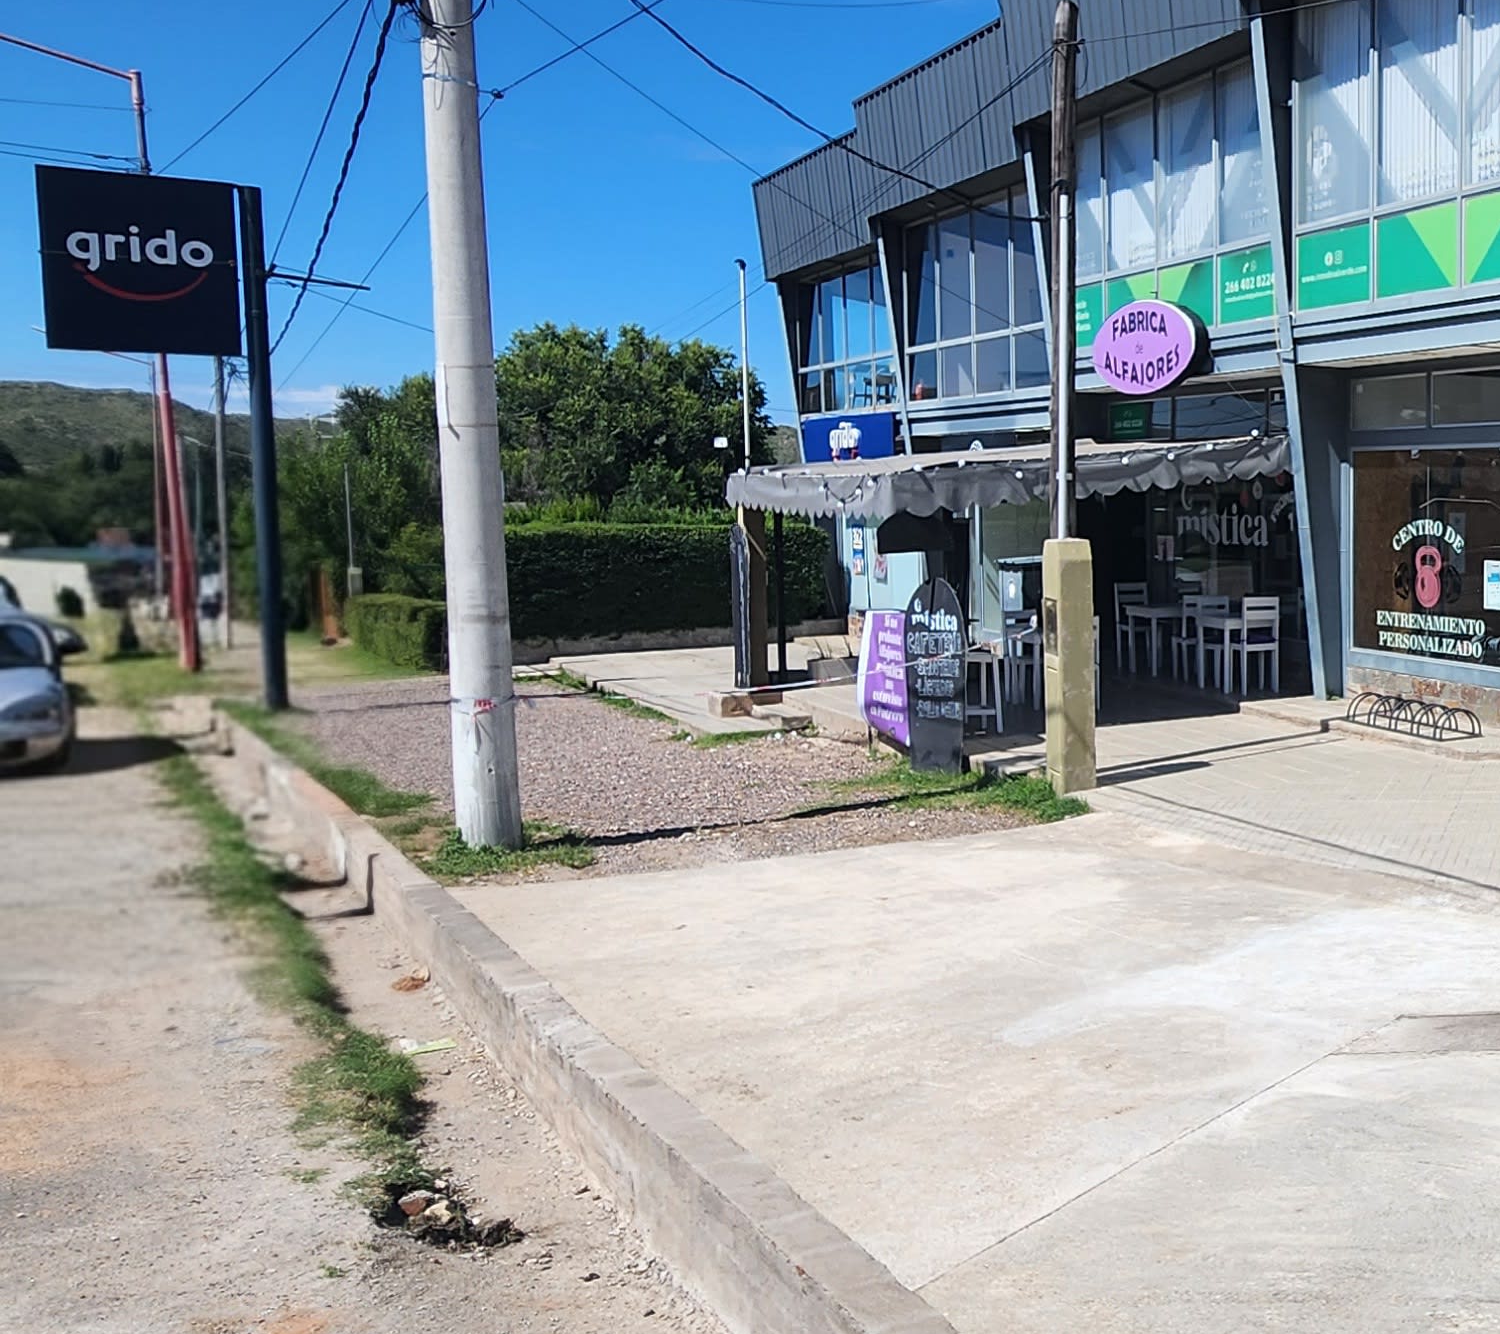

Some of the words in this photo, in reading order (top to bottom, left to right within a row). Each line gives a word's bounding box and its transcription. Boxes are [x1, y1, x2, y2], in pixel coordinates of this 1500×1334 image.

[66, 225, 214, 272] grido
[1112, 310, 1168, 342] FABRICA
[1135, 341, 1144, 354] de
[1104, 343, 1180, 386] ALFAJORES
[1392, 518, 1443, 551] CENTRO
[1443, 525, 1465, 554] DE
[1376, 610, 1486, 636] ENTRENAMIENTO
[1378, 630, 1483, 658] PERSONALIZADO
